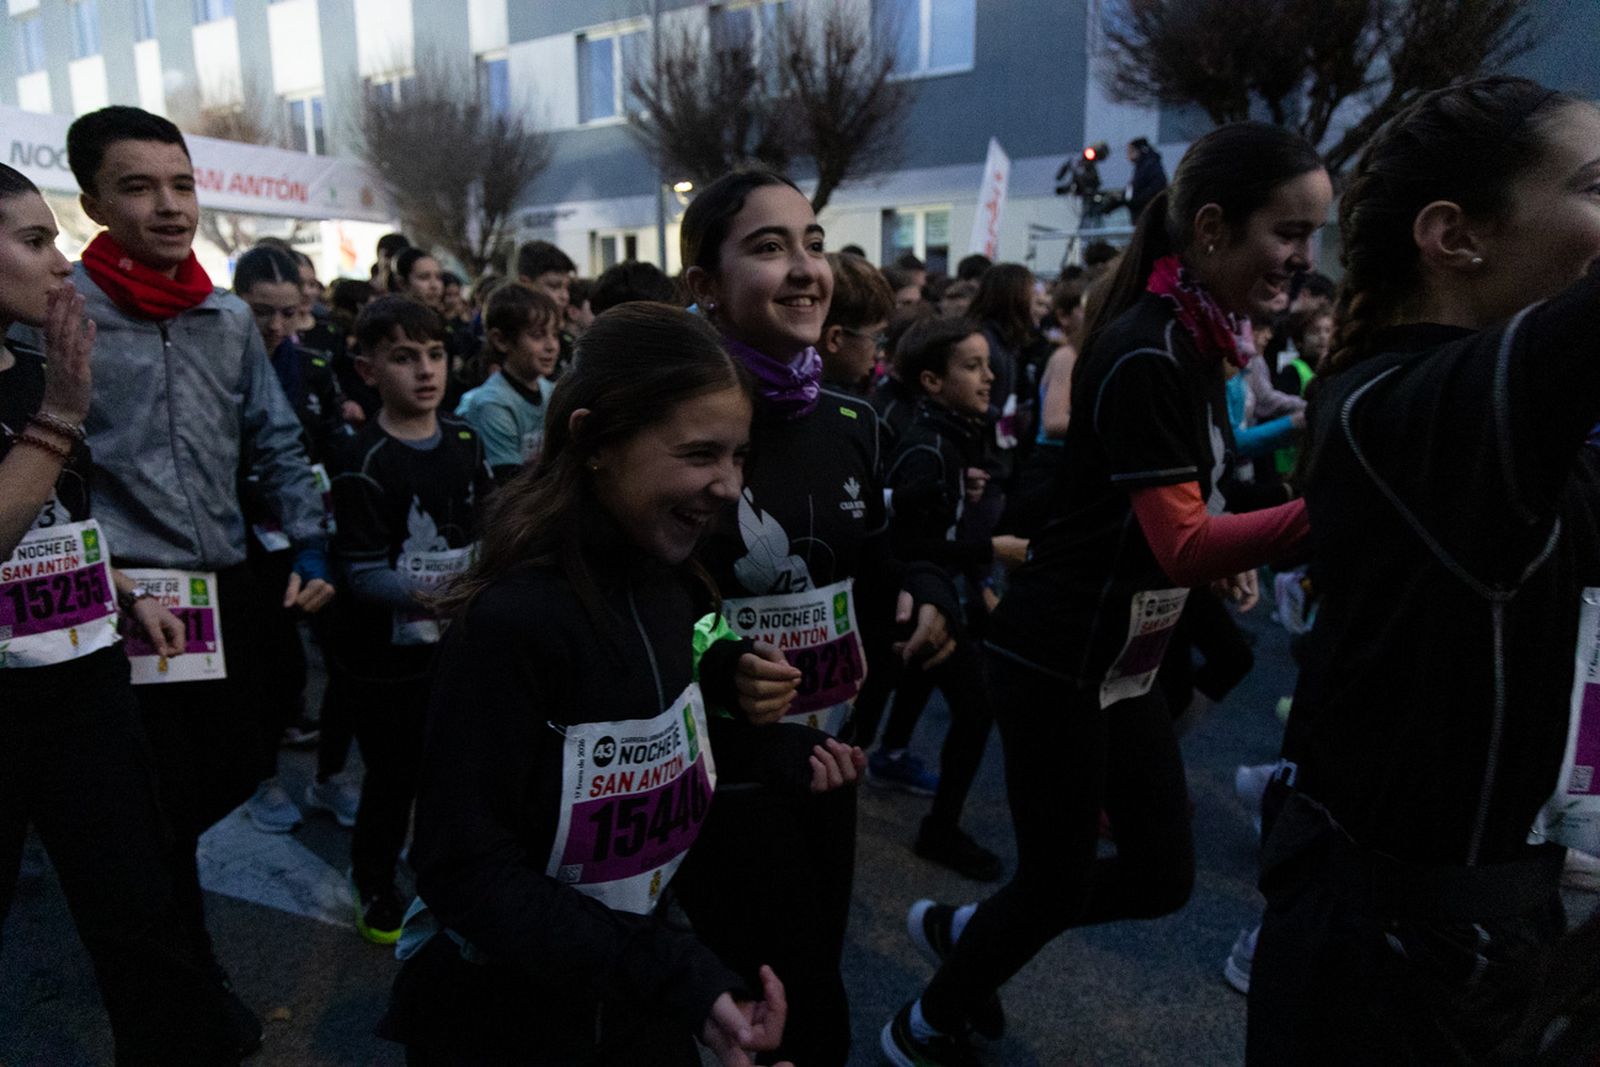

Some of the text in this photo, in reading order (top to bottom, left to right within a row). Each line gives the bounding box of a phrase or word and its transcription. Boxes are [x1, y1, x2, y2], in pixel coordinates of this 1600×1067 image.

[10, 141, 70, 171] NOC
[194, 167, 224, 191] AN
[39, 500, 56, 528] 3
[18, 541, 62, 560] NOCHE
[64, 539, 77, 553] DE
[2, 564, 32, 581] SAN
[6, 567, 105, 624] 15255
[760, 610, 810, 629] NOCHE
[812, 607, 827, 623] DE
[779, 624, 829, 648] ANTÓN
[796, 639, 855, 694] 823
[593, 741, 615, 760] 43
[618, 736, 671, 765] NOCHE
[590, 772, 634, 798] SAN
